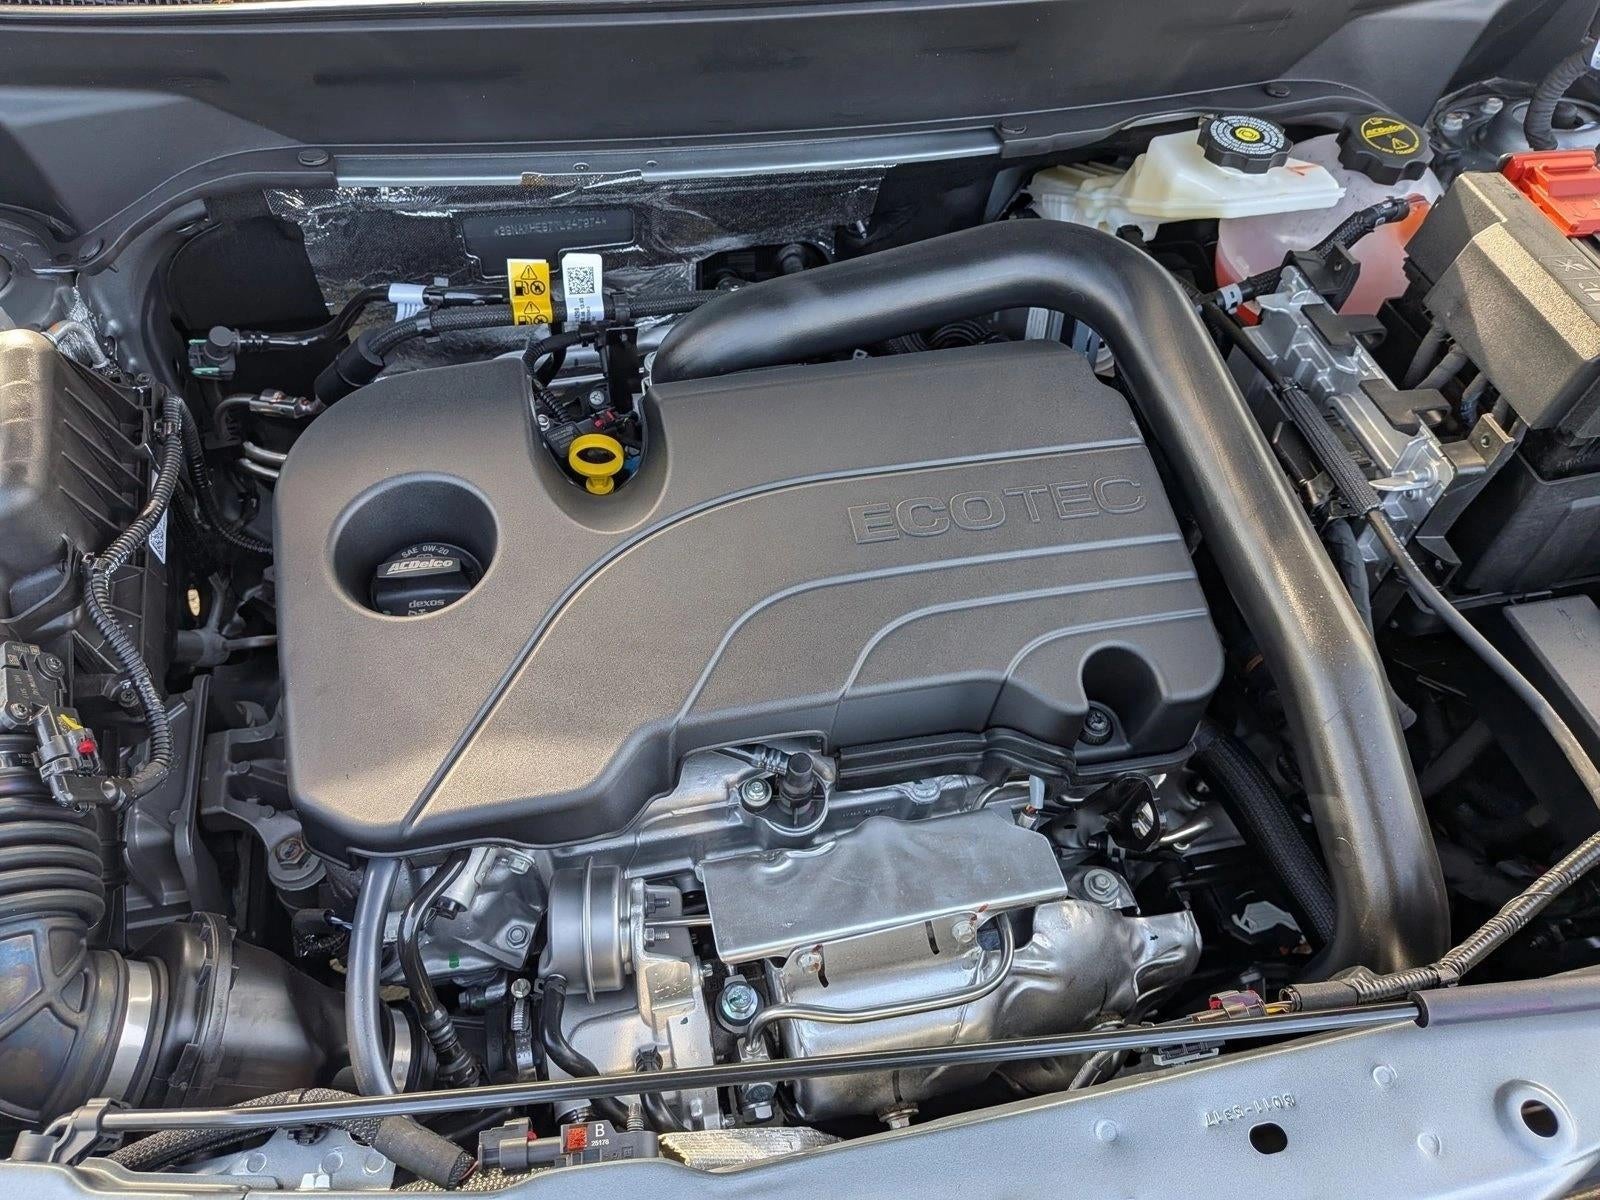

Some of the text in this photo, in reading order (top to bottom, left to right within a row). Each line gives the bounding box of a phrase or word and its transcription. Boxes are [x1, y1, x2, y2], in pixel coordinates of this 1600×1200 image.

[847, 475, 1147, 544] ECOTEC
[401, 545, 449, 558] SAE 0W-20
[386, 559, 454, 575] ACDelco
[408, 599, 445, 608] dexos
[595, 1123, 605, 1138] B
